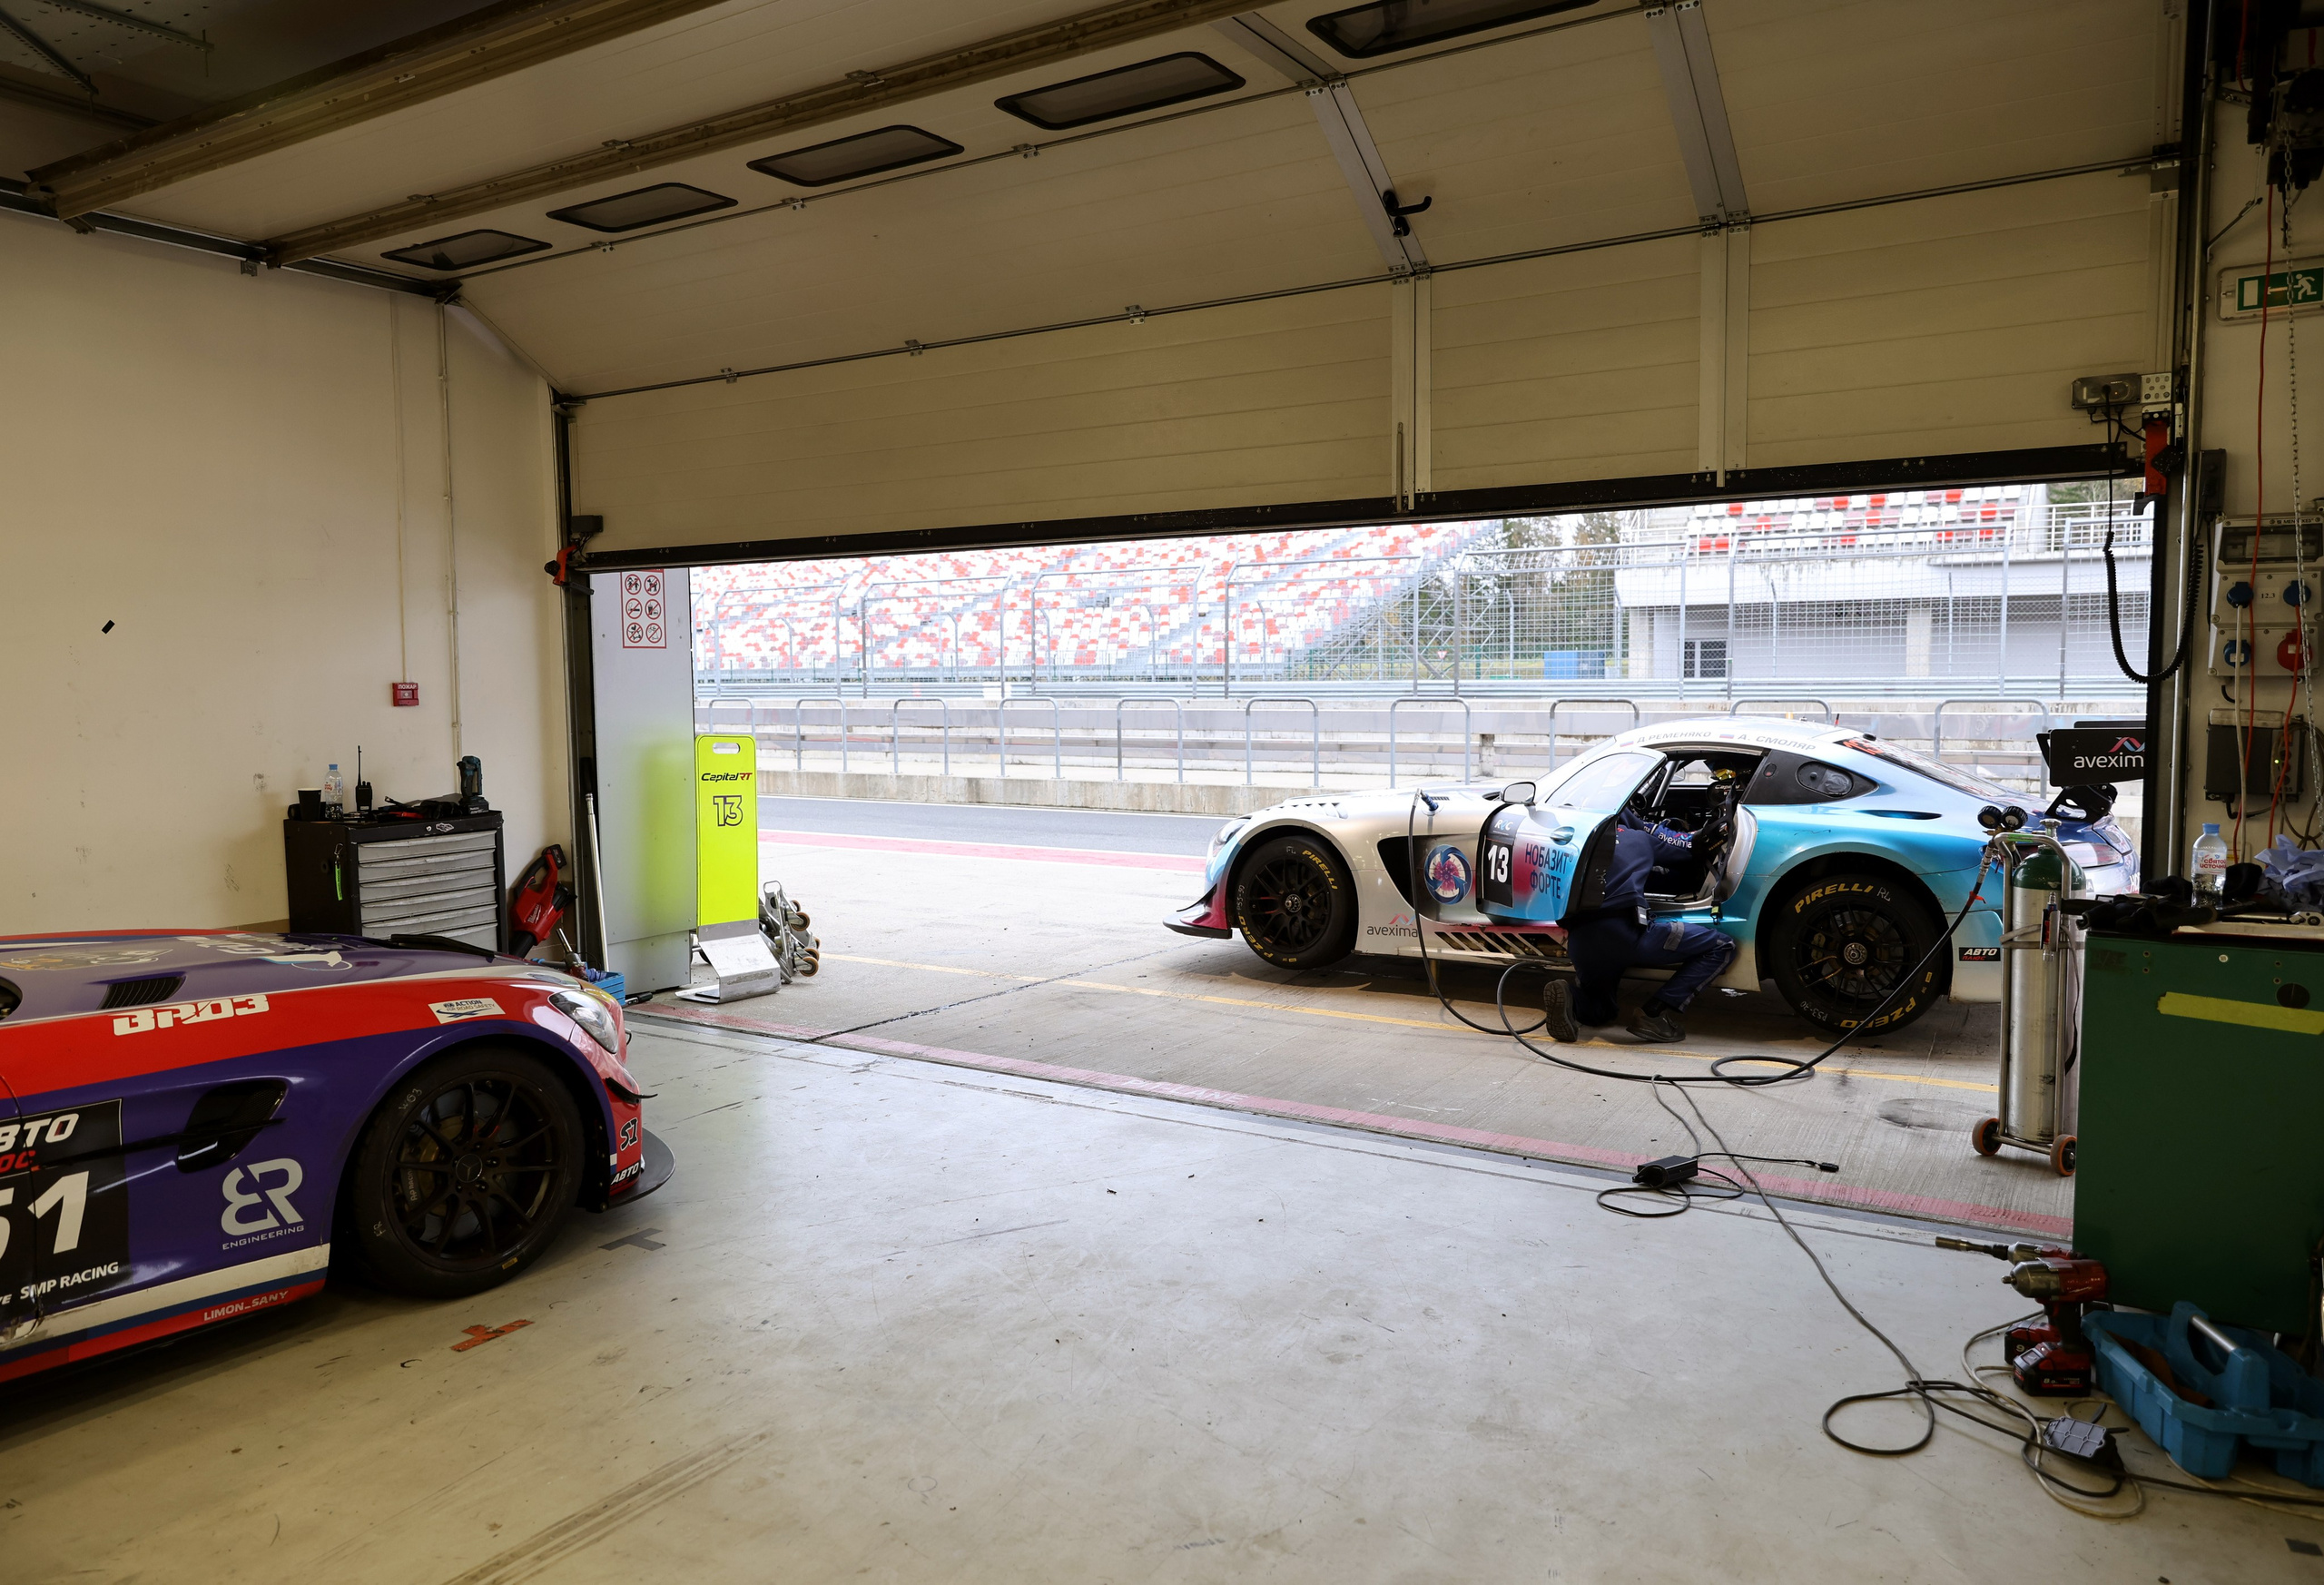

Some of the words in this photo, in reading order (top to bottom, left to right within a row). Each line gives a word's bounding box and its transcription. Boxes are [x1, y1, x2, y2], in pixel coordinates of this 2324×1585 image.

[1756, 735, 1817, 751] СМОЛЯР
[2073, 752, 2144, 769] avexim
[713, 794, 743, 827] 13
[1658, 832, 1692, 849] avexima
[1302, 850, 1338, 890] PIRELLI
[1487, 844, 1510, 883] 13
[1530, 869, 1561, 899] ФОРТЕ
[1794, 882, 1875, 914] PIRELLI
[1366, 924, 1418, 938] avexima
[222, 1225, 305, 1251] ENGINEERING
[19, 1278, 57, 1300] SMP
[60, 1262, 119, 1289] RACING
[203, 1290, 289, 1322] LIMON_SANY
